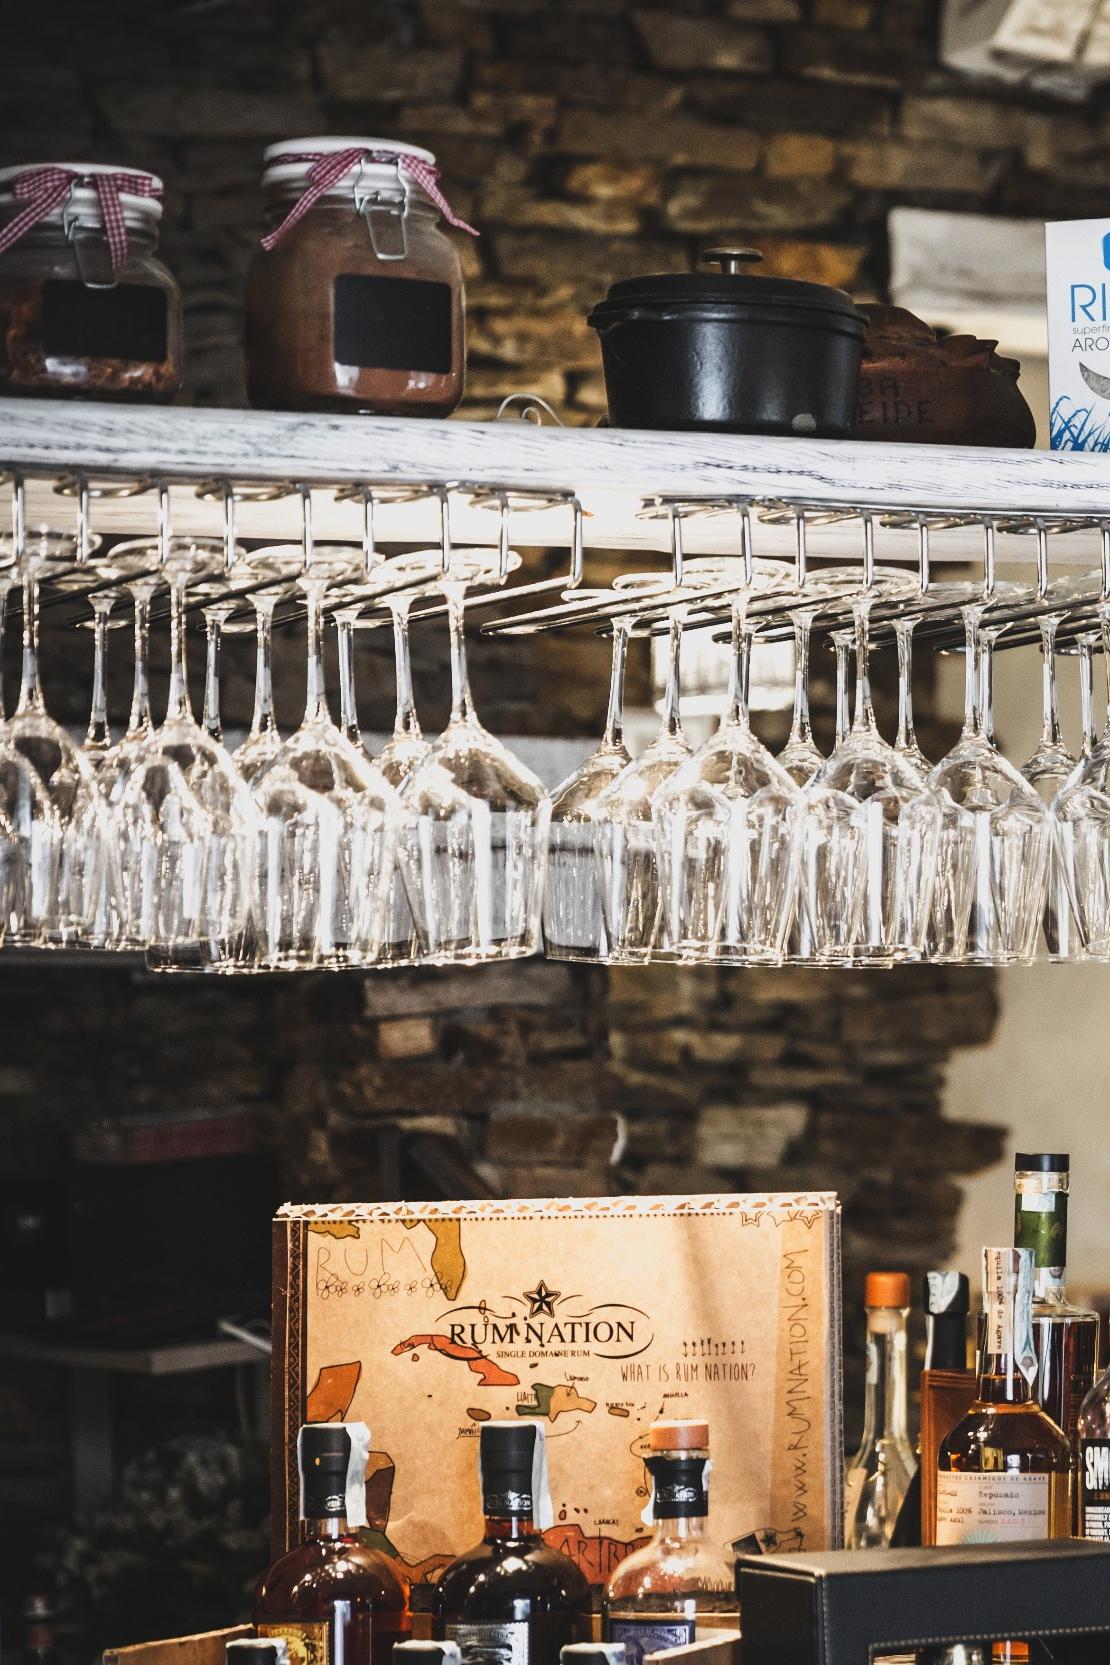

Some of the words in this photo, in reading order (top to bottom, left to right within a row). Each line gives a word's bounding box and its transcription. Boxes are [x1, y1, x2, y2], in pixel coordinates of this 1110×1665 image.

[315, 1236, 427, 1297] RUM
[449, 1322, 517, 1348] RUM
[525, 1320, 637, 1345] NATION
[995, 1324, 1004, 1350] Agave
[495, 1350, 527, 1358] SINGLE
[528, 1349, 569, 1358] DOMAINE
[570, 1349, 591, 1358] RUM
[620, 1364, 651, 1382] WHAT
[658, 1363, 670, 1382] IS
[675, 1363, 698, 1382] RUM
[704, 1362, 756, 1382] NATION?
[978, 1491, 1020, 1499] Reposado
[977, 1508, 1016, 1516] Jalisco,
